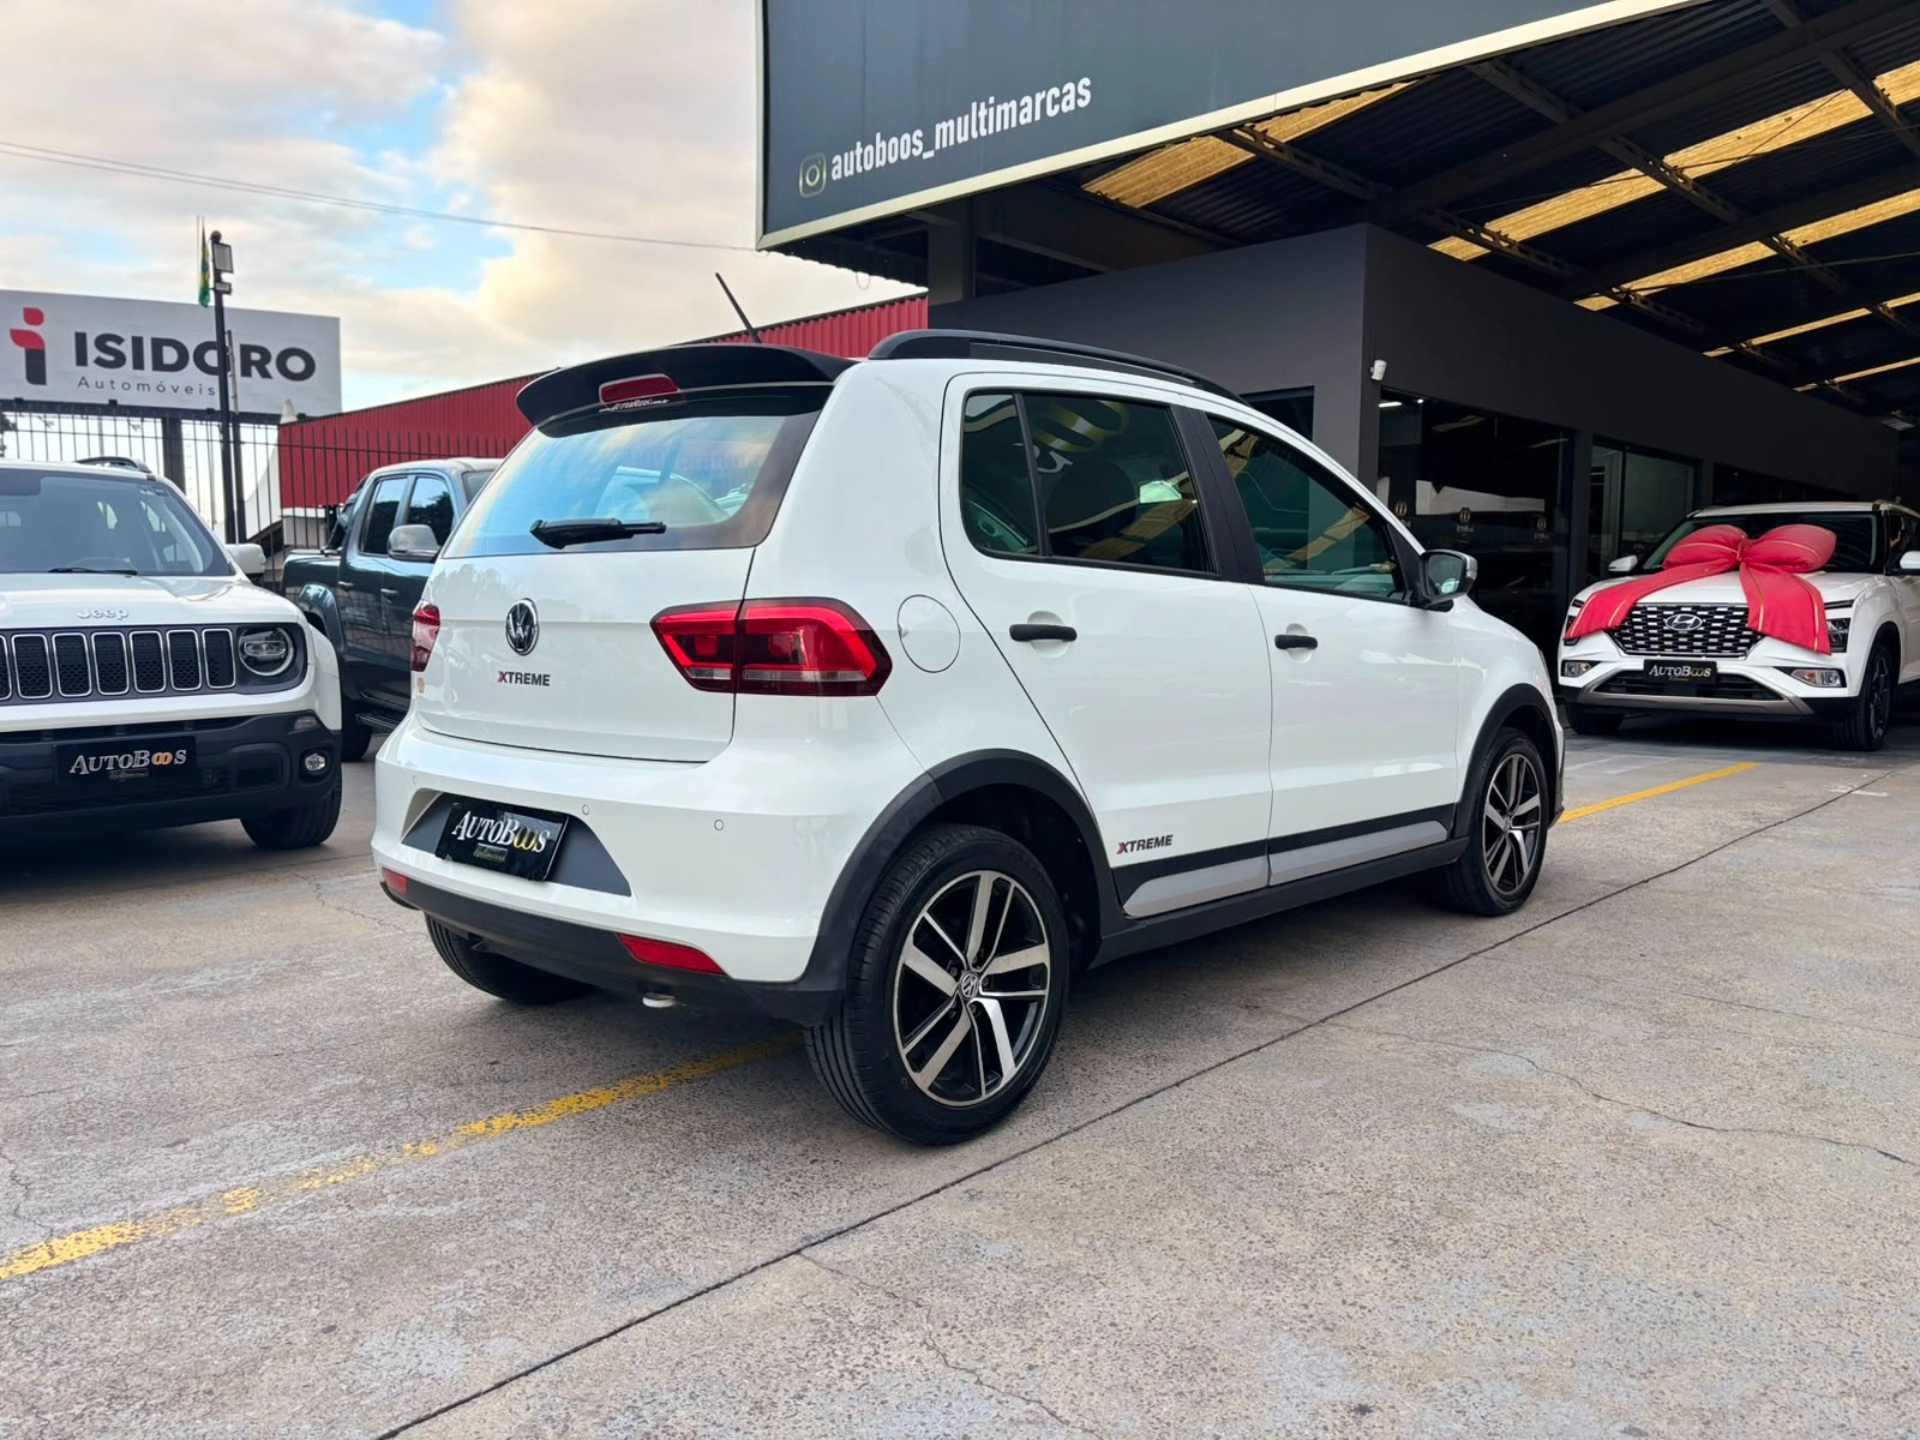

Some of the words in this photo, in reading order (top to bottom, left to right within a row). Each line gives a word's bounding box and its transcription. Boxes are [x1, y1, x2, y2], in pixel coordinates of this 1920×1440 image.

[831, 77, 1092, 181] autoboos_multimarcas
[74, 331, 317, 382] ISIDORO
[77, 375, 217, 396] Automóveis
[77, 607, 129, 620] Jeep
[497, 671, 551, 687] XTREME
[1116, 834, 1174, 855] XTREME
